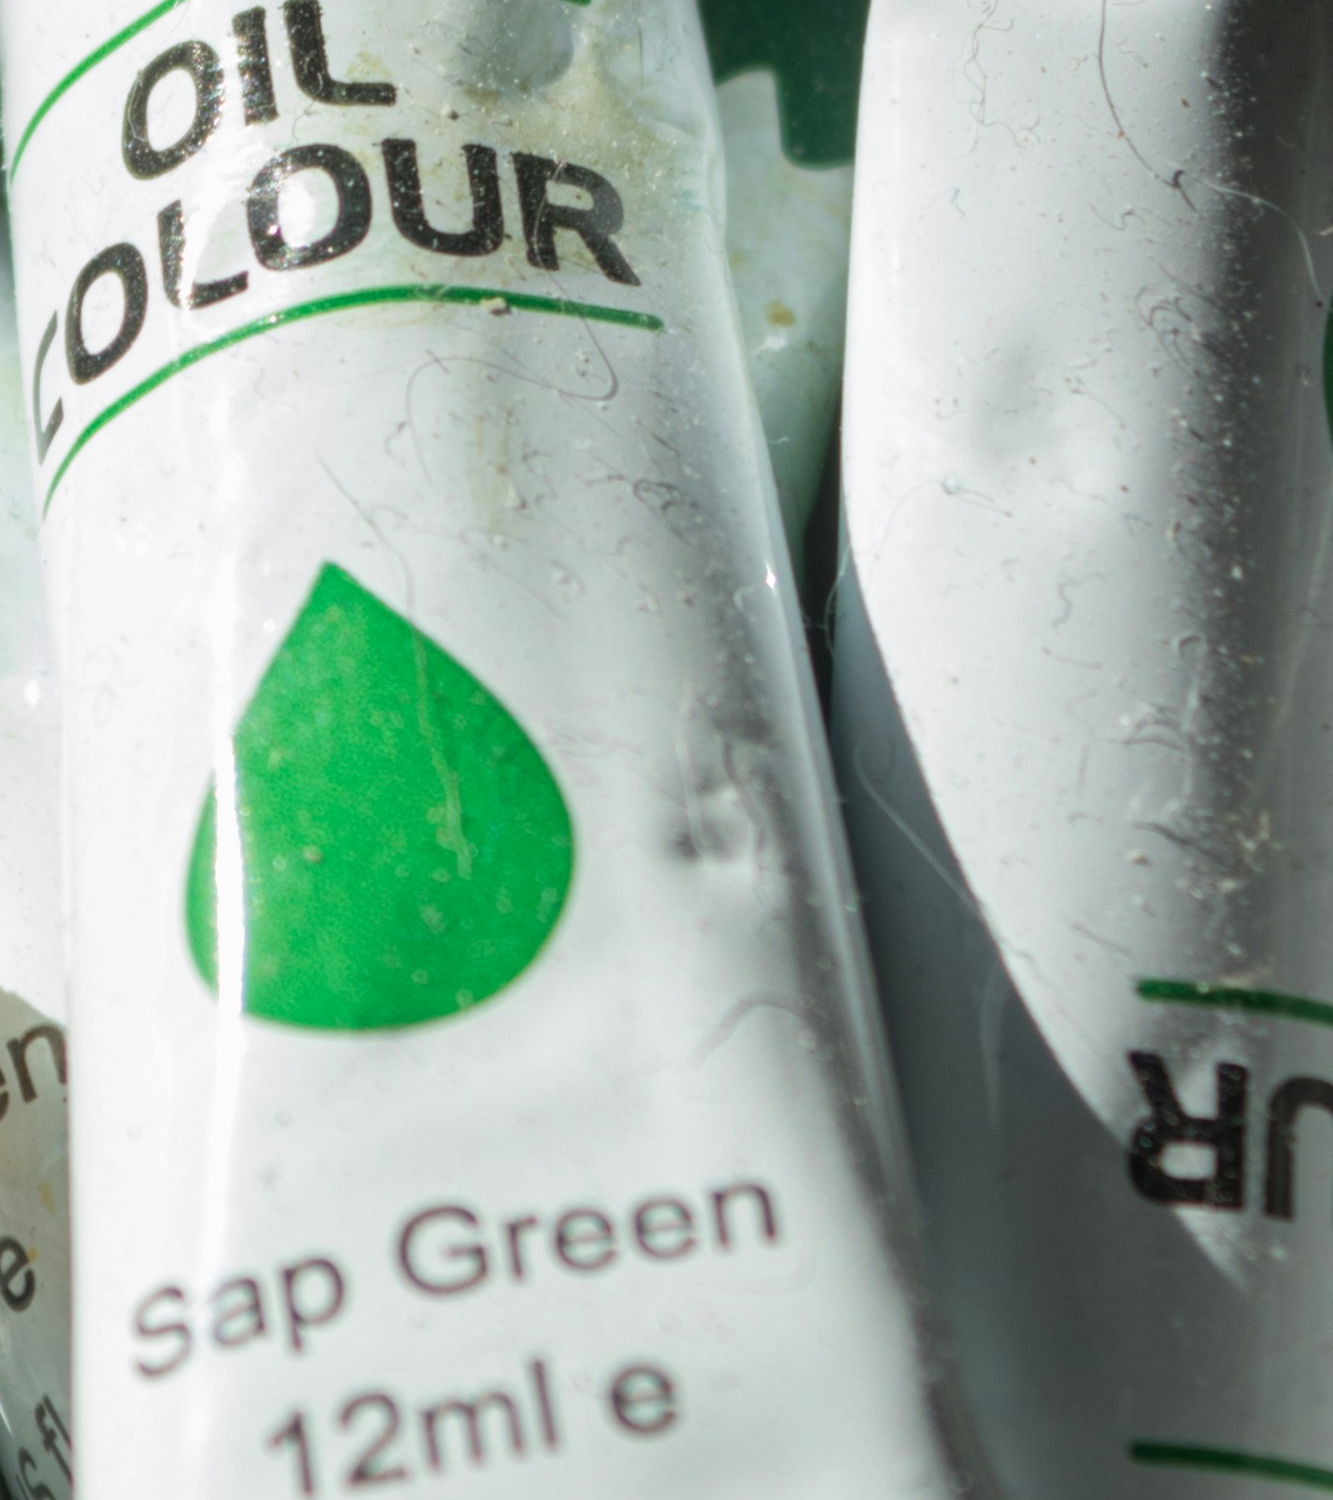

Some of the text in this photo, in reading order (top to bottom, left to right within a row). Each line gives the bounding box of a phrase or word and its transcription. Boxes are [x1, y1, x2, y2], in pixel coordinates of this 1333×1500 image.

[34, 139, 641, 466] COLOUR
[131, 1252, 348, 1378] Sap
[397, 1176, 782, 1296] Green
[266, 1357, 563, 1500] 12ml
